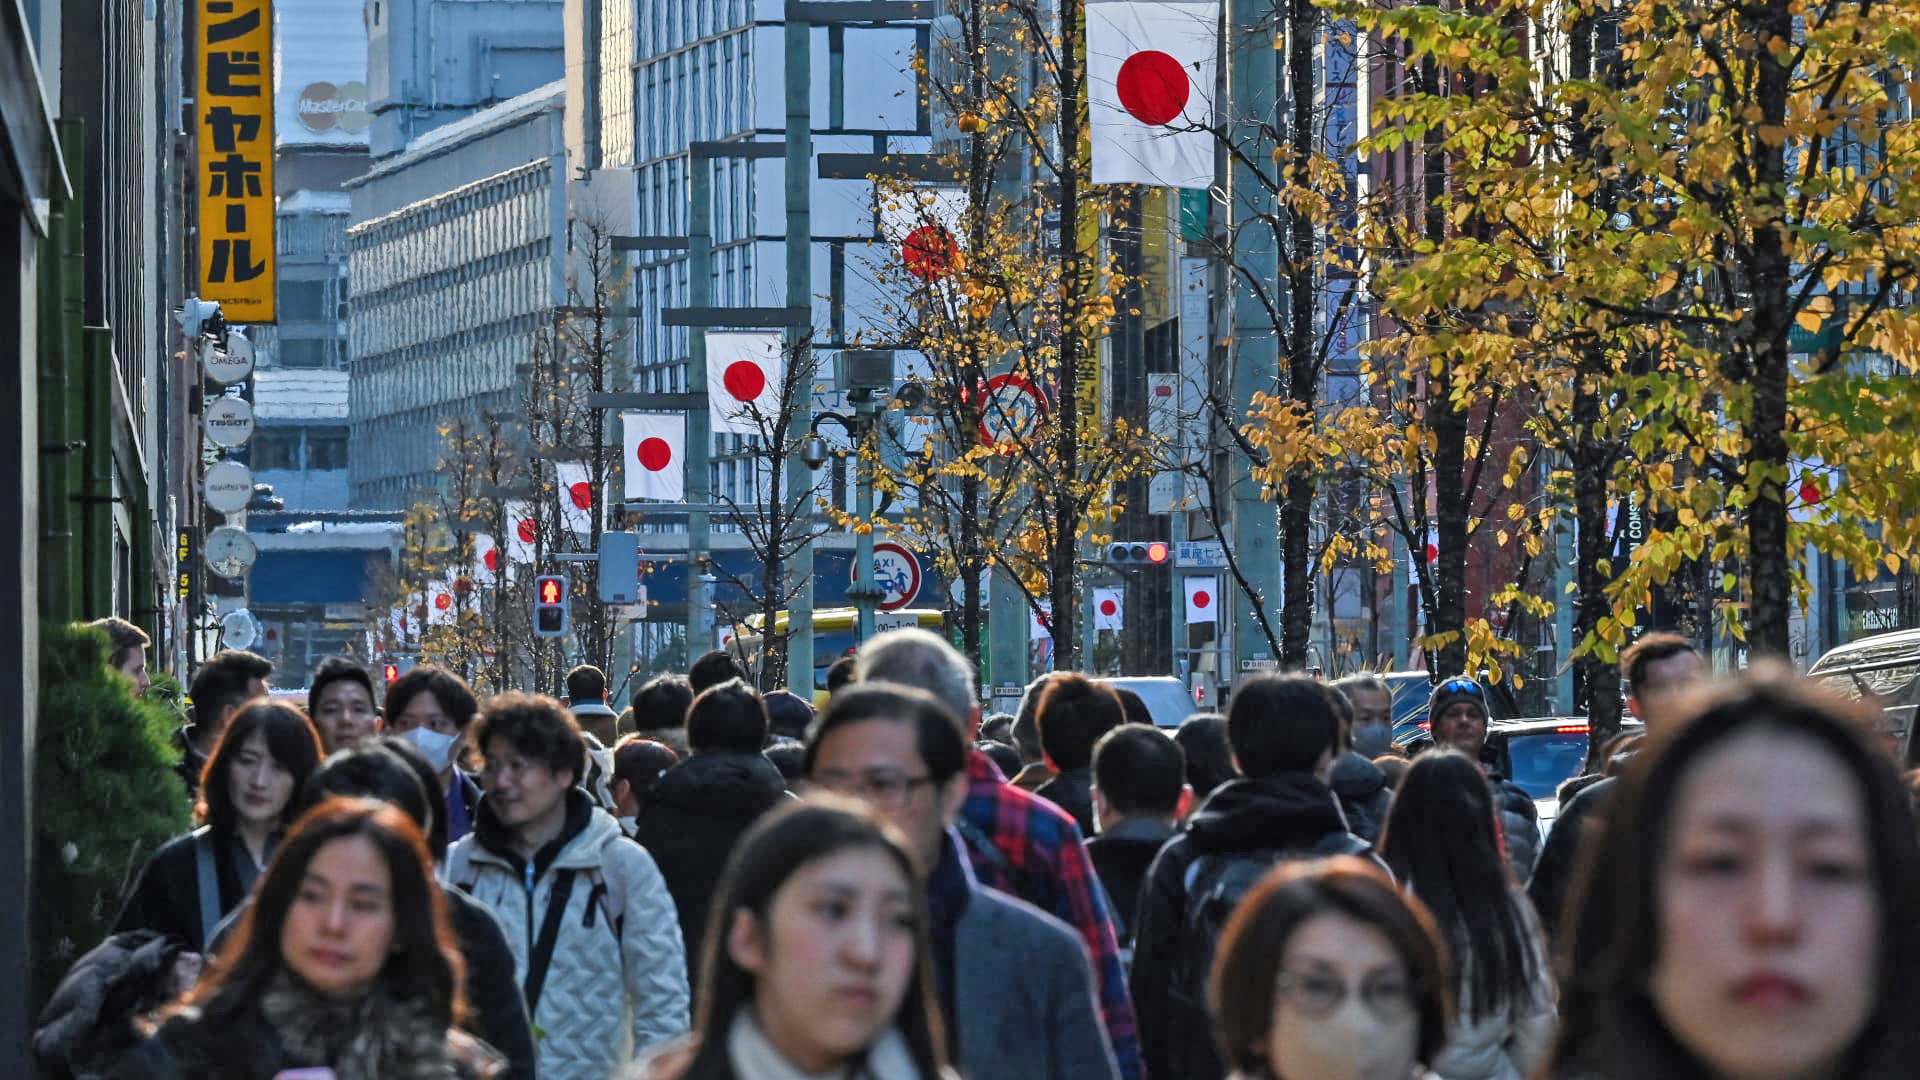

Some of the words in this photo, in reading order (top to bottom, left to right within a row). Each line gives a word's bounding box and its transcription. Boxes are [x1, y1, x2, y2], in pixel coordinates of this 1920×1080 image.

[300, 99, 368, 113] MasterCar
[210, 356, 248, 365] OMEGA
[874, 558, 895, 567] AXI
